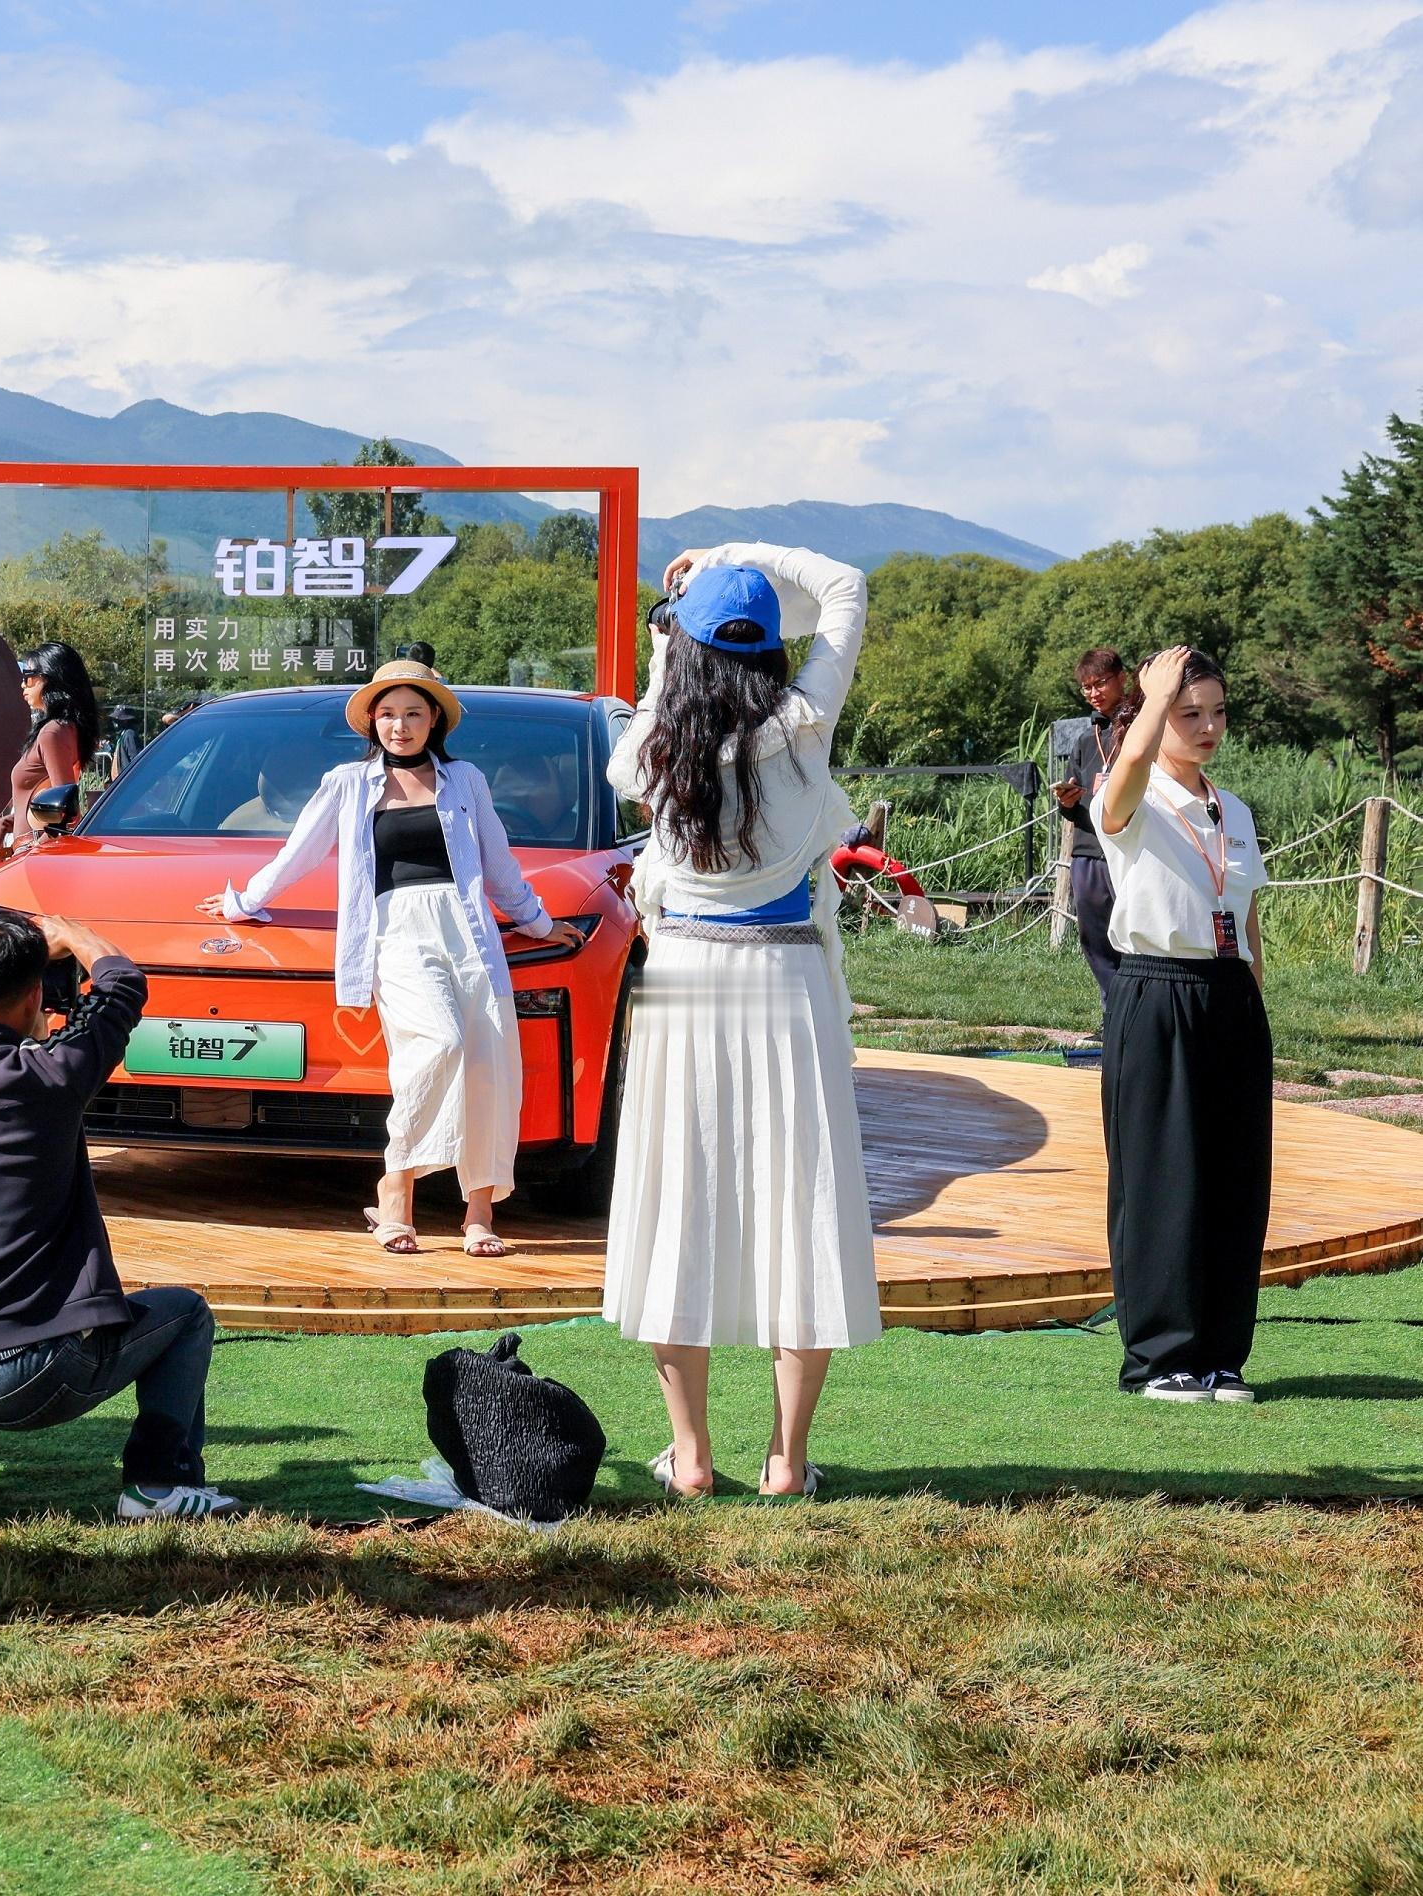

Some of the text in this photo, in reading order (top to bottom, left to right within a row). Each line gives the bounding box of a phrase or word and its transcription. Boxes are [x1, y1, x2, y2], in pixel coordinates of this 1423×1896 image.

[215, 537, 457, 596] 铂智7
[153, 617, 240, 642] 用实力
[153, 649, 367, 672] 再次被世界看见
[169, 1037, 258, 1060] 铂智7
